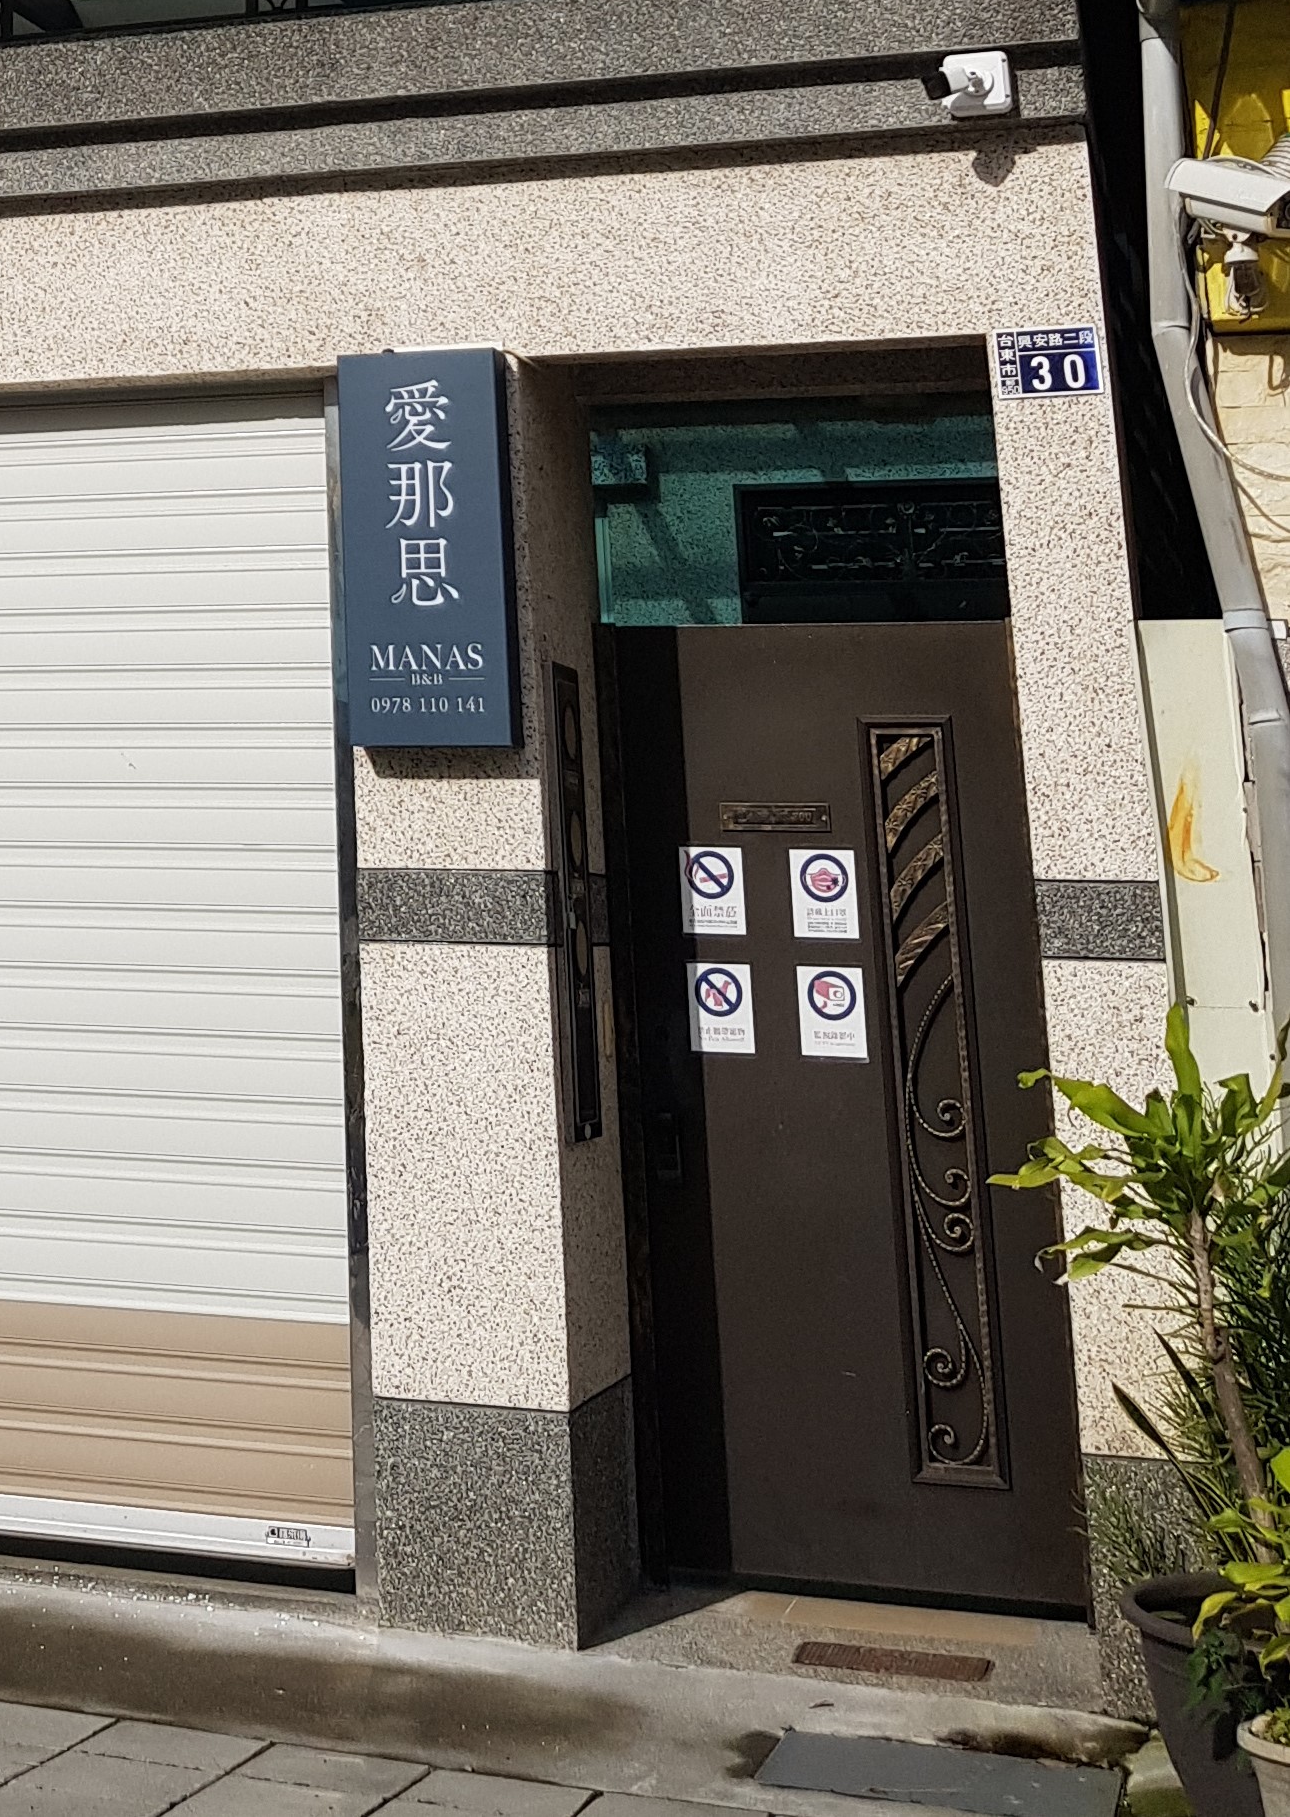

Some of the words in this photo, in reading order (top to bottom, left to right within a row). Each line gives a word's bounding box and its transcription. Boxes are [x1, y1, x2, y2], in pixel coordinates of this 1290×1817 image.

[1017, 330, 1093, 348] 興安路二段
[998, 335, 1017, 376] 台東市
[1030, 354, 1086, 390] 30
[385, 379, 459, 606] 愛那思
[370, 643, 484, 671] MANAS
[411, 673, 443, 686] B&B
[371, 697, 411, 714] 0978
[419, 697, 448, 713] 110
[456, 696, 485, 713] 141
